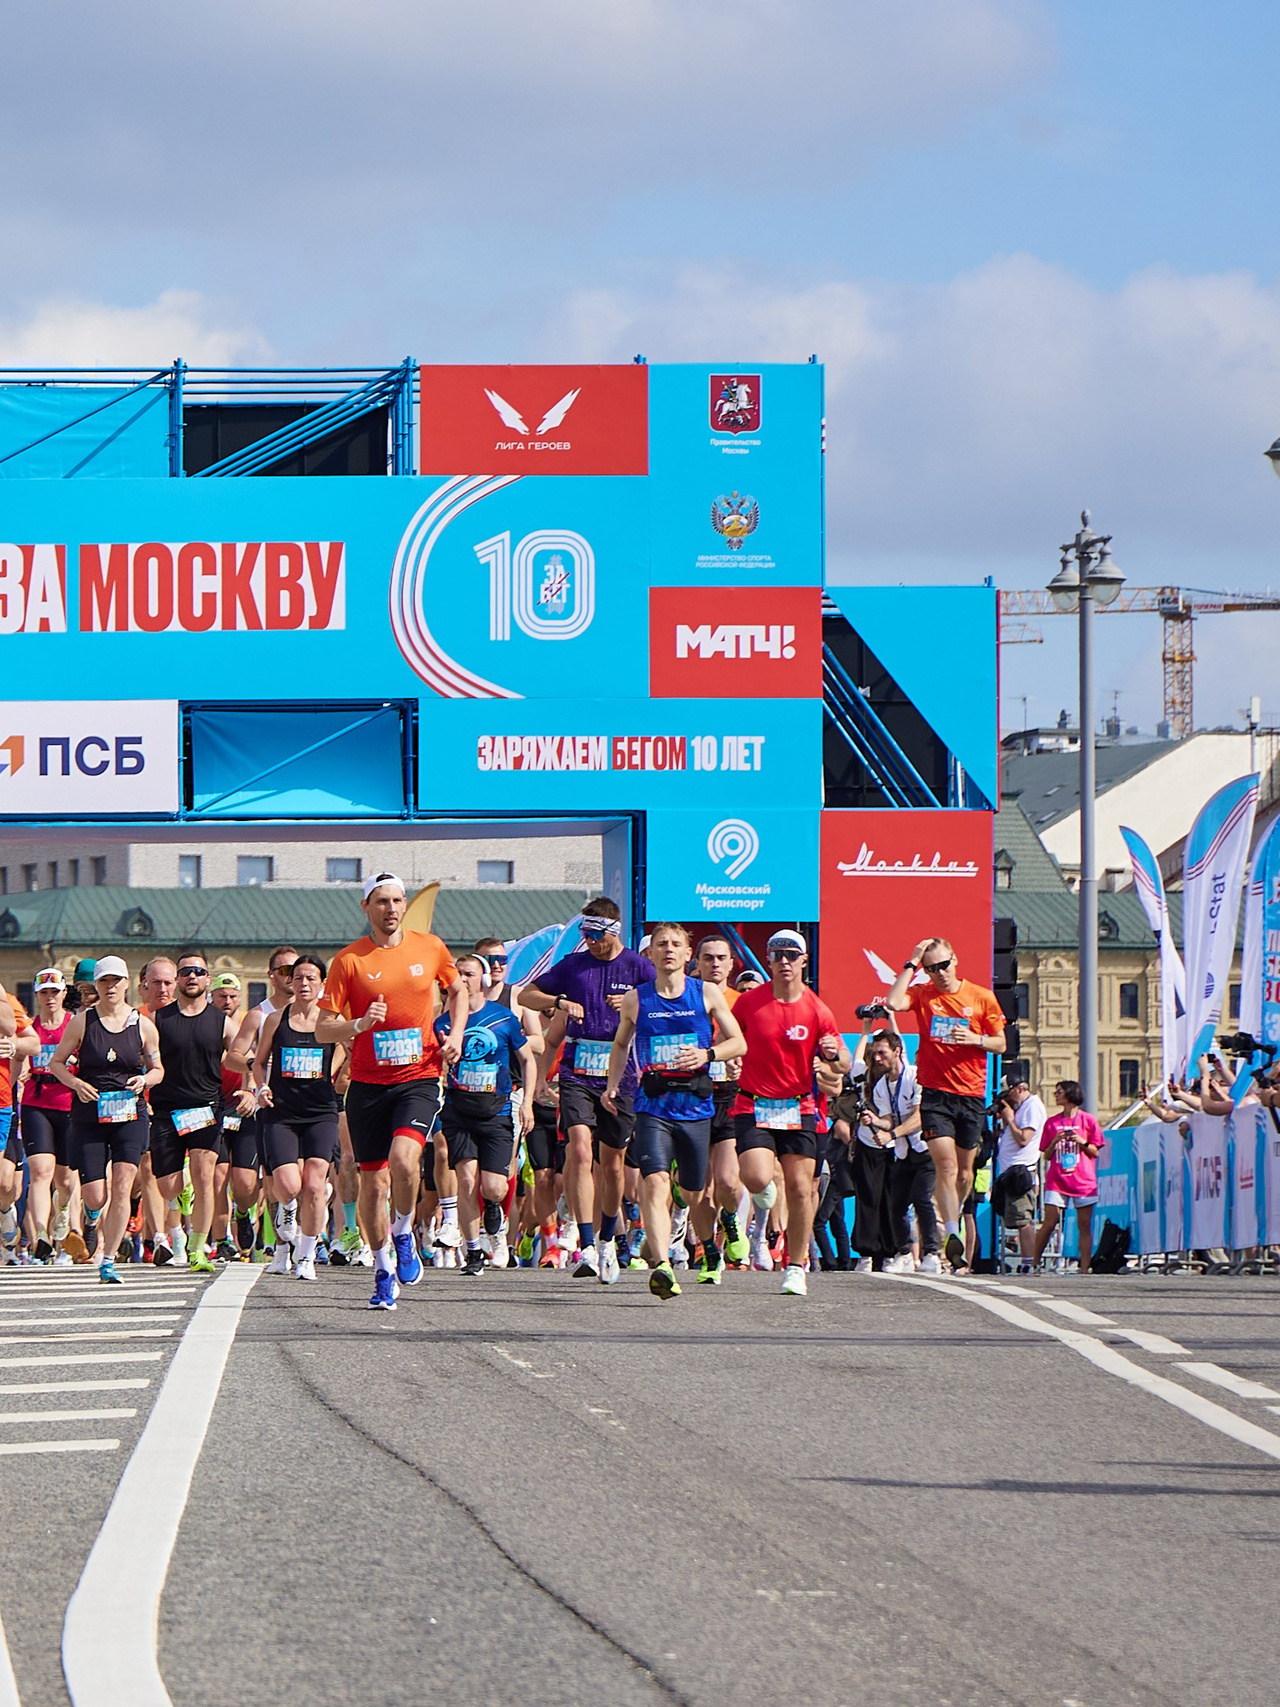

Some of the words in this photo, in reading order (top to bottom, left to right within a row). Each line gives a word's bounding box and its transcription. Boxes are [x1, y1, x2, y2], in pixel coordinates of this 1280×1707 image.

[494, 442, 525, 450] ЛИГА
[528, 442, 571, 450] ГЕРОЕВ
[78, 541, 346, 633] МОСКВУ
[473, 529, 596, 641] 10
[676, 624, 796, 660] МАТЧ!
[38, 735, 146, 777] ПСБ
[477, 735, 608, 771] ЗАРЯЖАЕМ
[611, 736, 687, 771] БЕГОМ
[690, 736, 718, 771] 10
[721, 736, 766, 771] ЛЕТ
[695, 883, 771, 896] Московский
[701, 896, 766, 911] Транспорт
[379, 1037, 418, 1058] 72031
